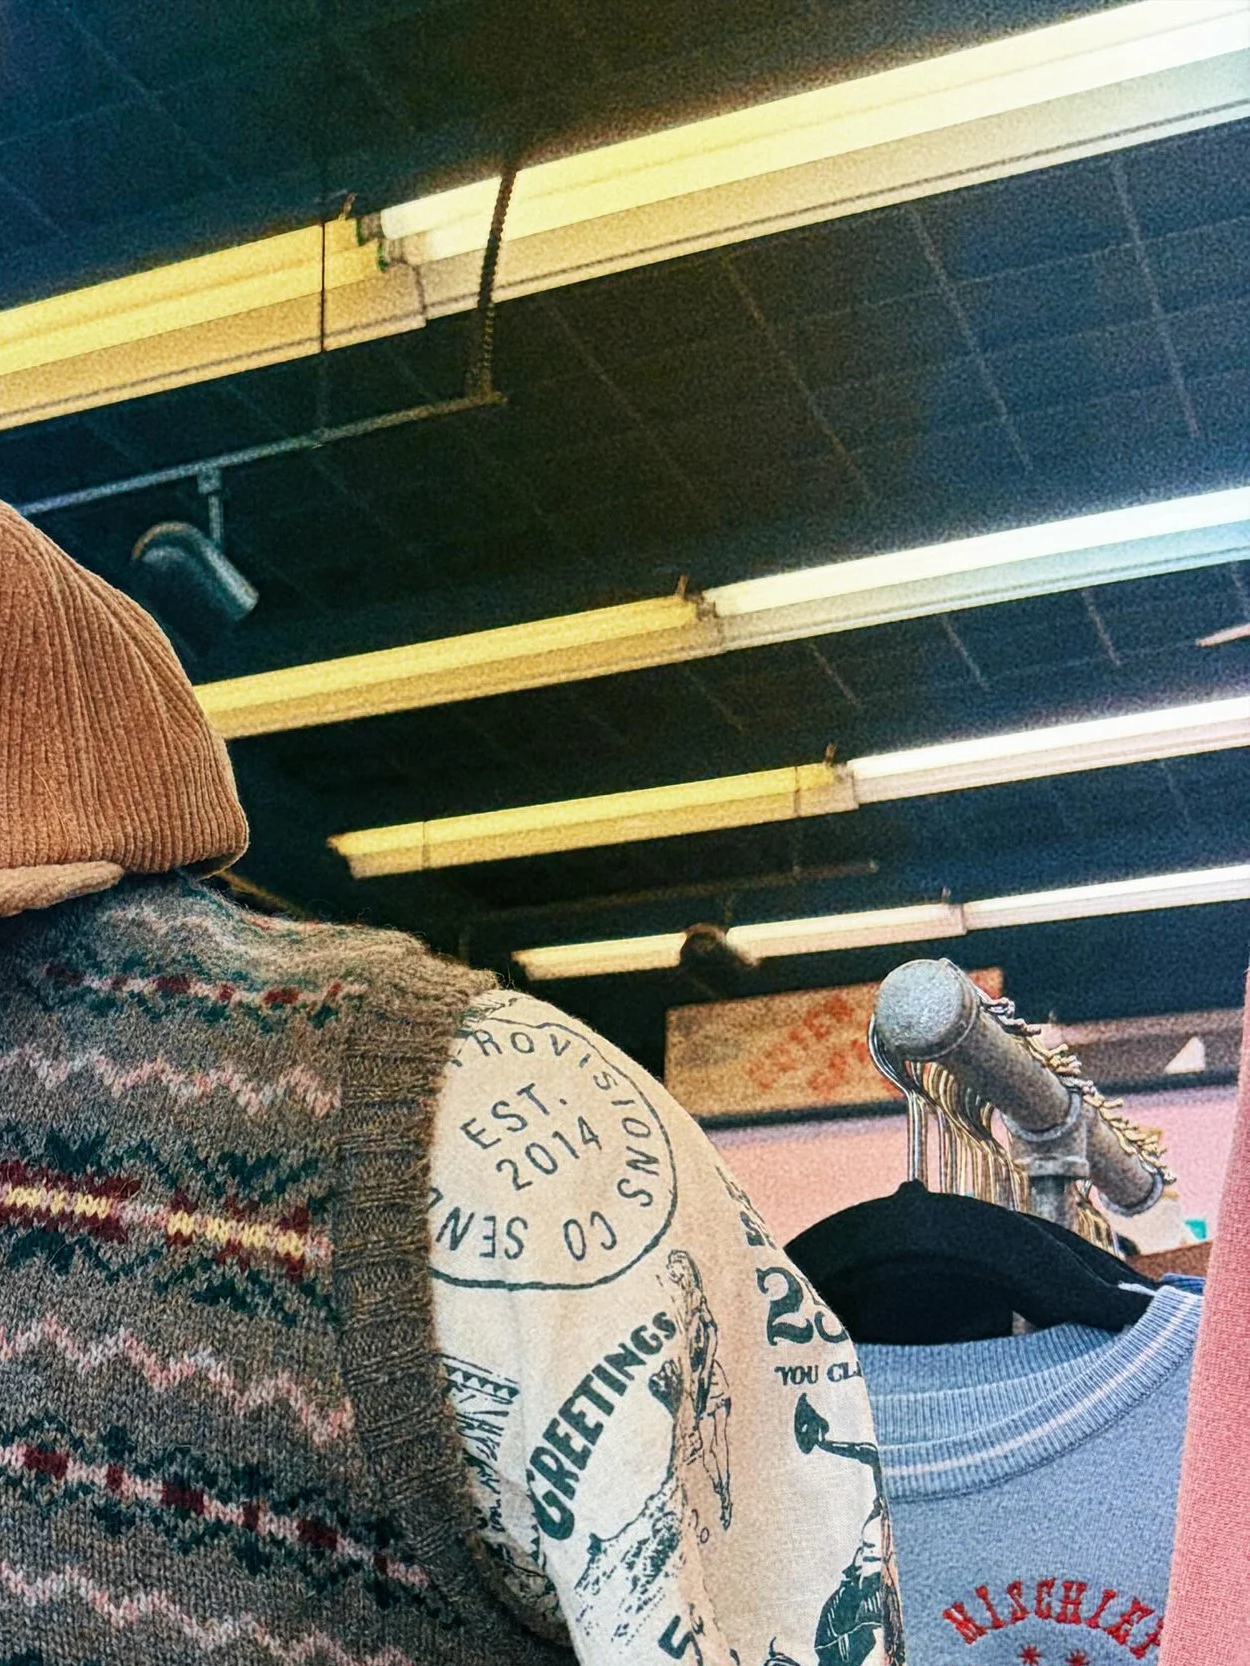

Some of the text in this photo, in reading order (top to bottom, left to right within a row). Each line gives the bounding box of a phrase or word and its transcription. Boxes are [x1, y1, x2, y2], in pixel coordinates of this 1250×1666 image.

[495, 1115, 603, 1191] 2014
[774, 1364, 819, 1386] YOU
[525, 1311, 677, 1541] GREETINGS
